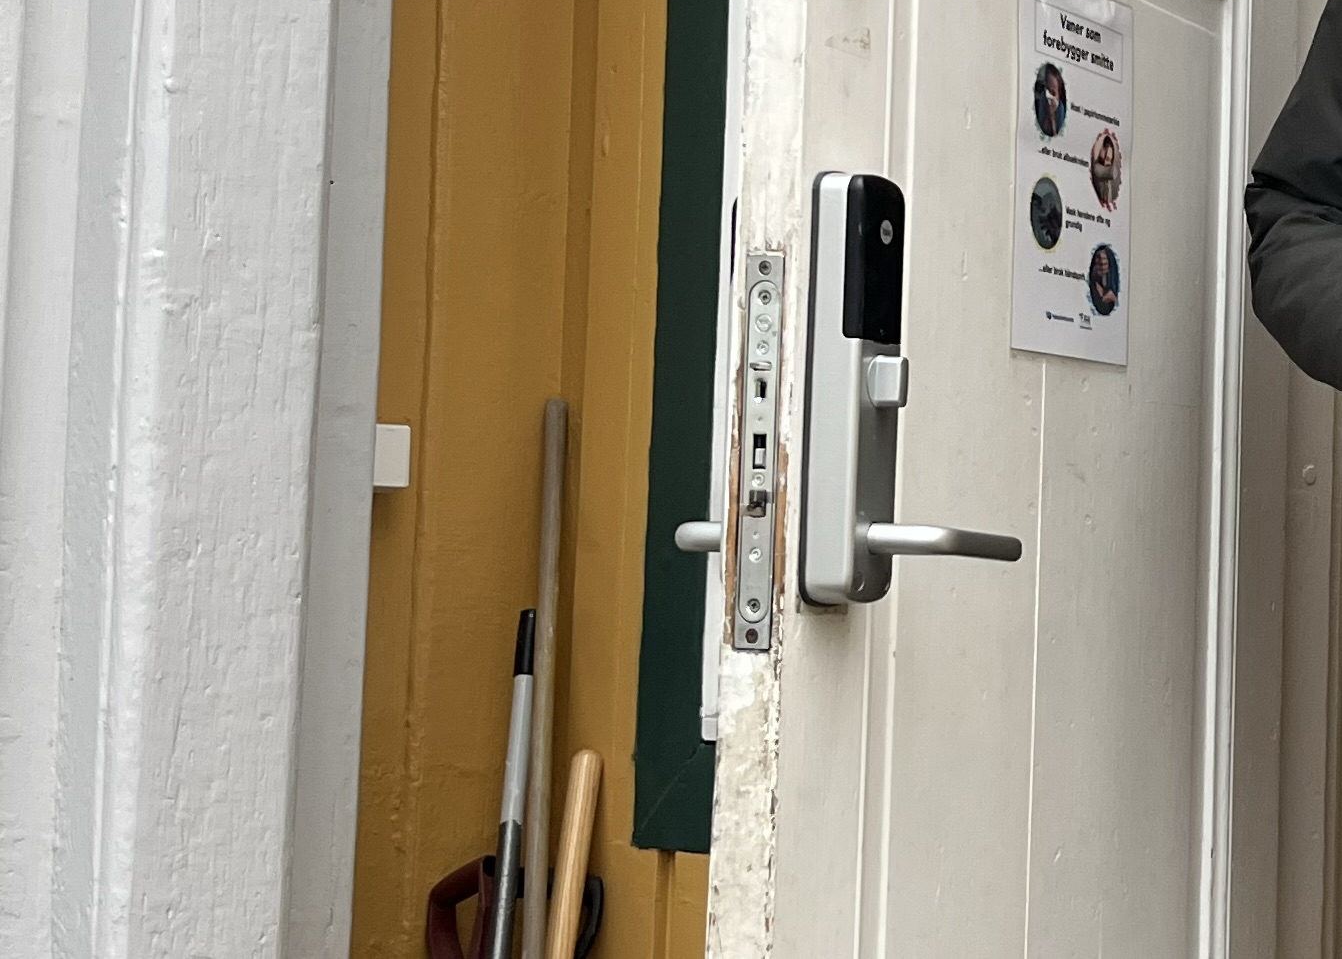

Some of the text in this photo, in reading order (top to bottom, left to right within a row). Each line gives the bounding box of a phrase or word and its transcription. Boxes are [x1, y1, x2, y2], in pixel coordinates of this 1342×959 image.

[1060, 13, 1101, 43] Vaner som
[1043, 30, 1114, 71] forebygger smitte
